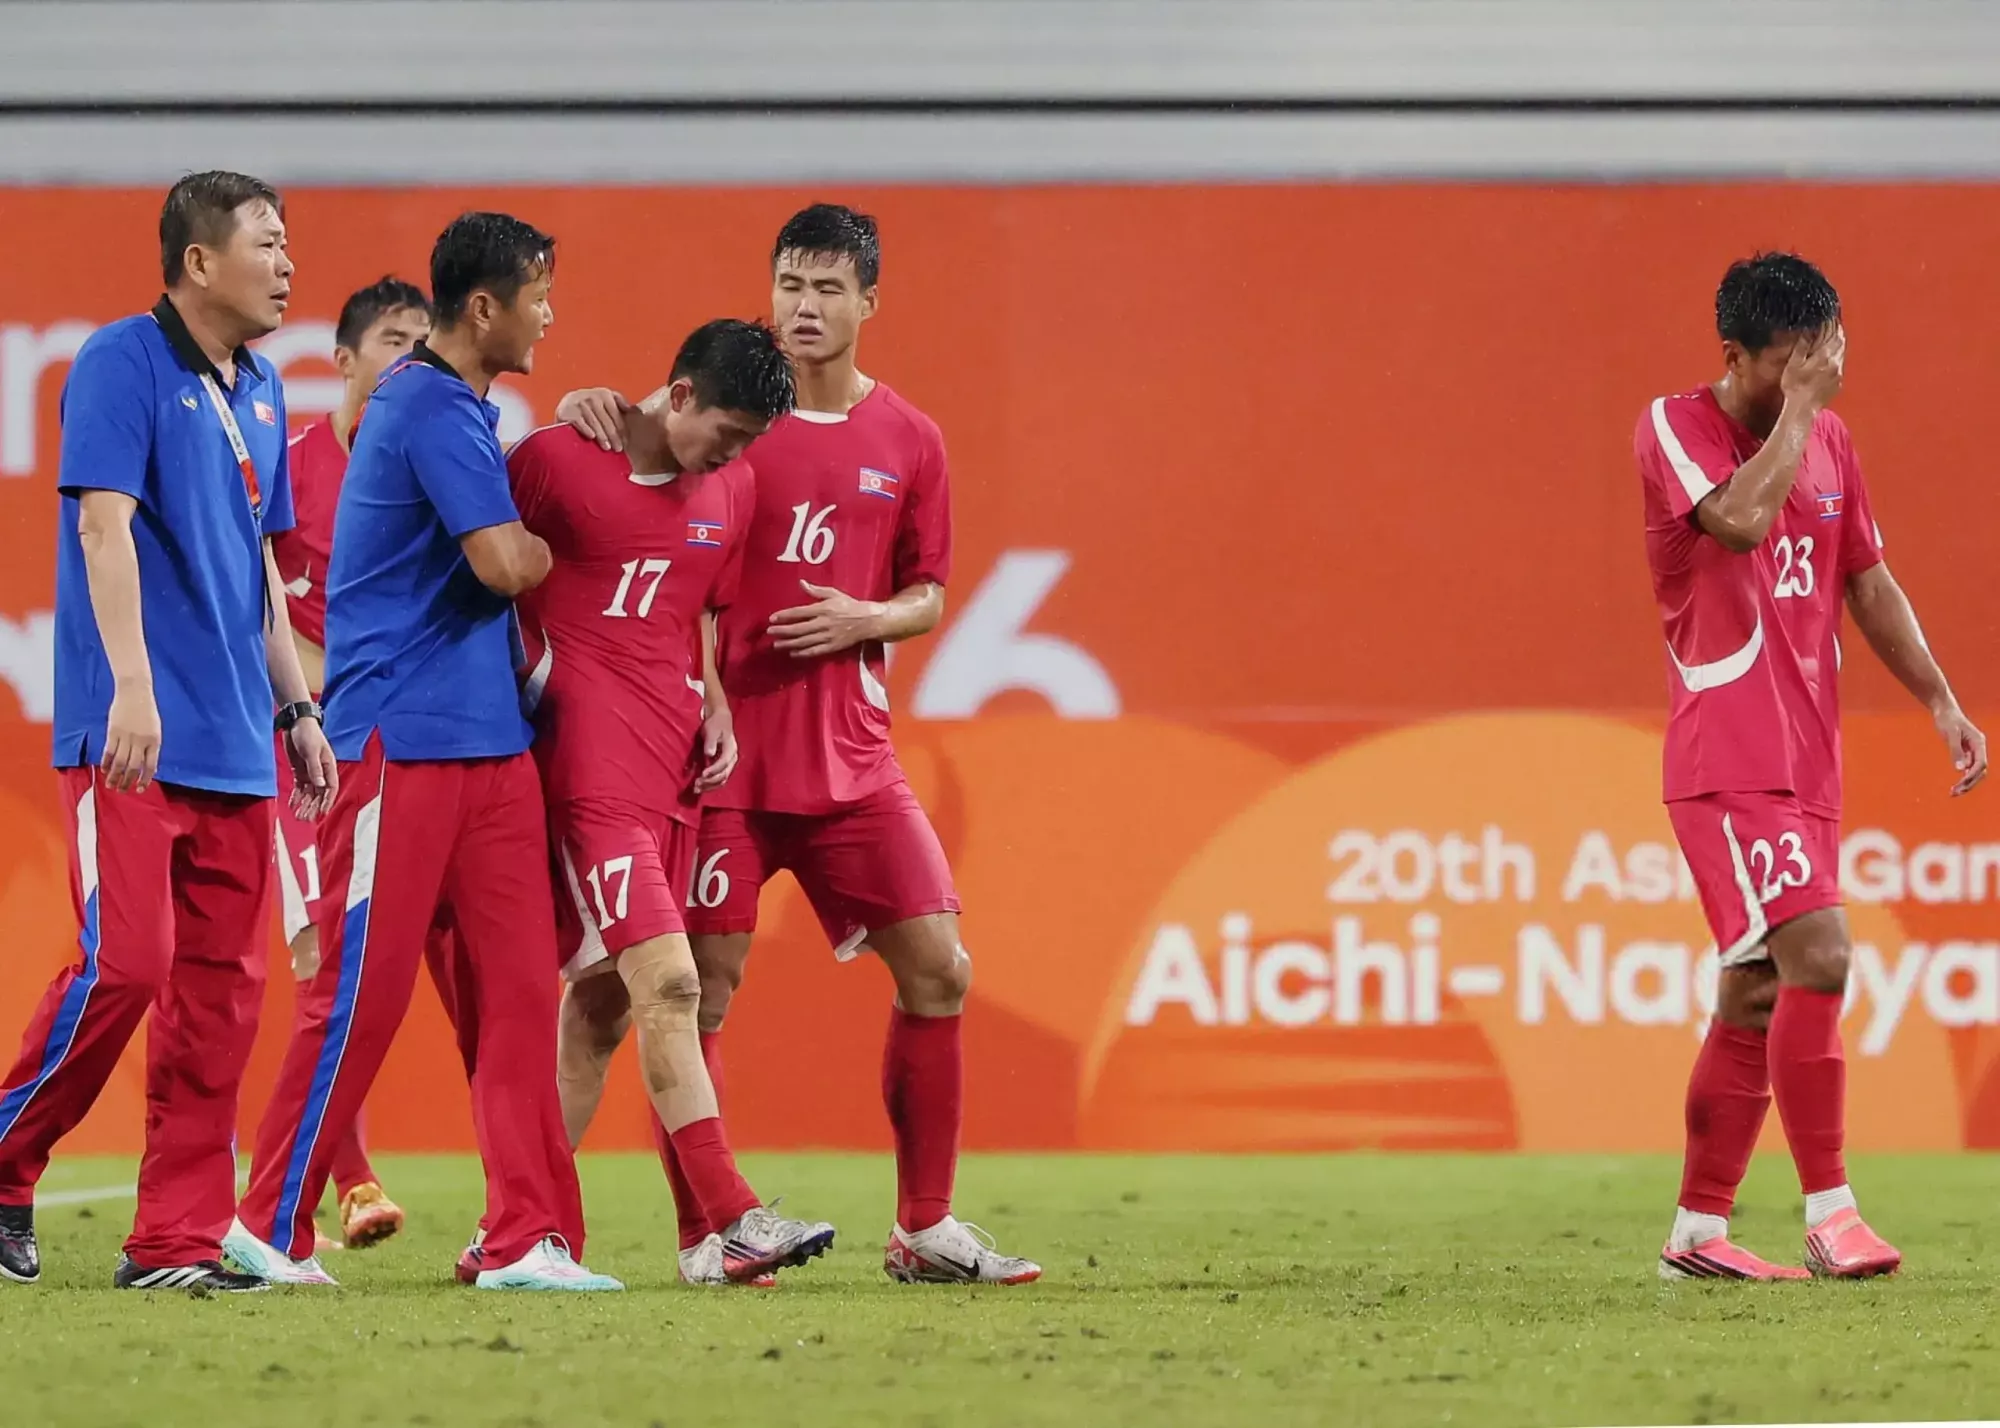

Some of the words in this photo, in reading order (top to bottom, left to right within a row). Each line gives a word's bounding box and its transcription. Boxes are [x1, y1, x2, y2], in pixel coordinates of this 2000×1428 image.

[776, 500, 837, 565] 16
[1773, 534, 1815, 599] 23
[601, 557, 672, 619] 17
[586, 855, 633, 931] 17
[685, 847, 731, 909] 16
[1325, 824, 1537, 904] 20th
[1751, 831, 1812, 904] 23
[1126, 911, 2000, 1056] Aichi-Naya
